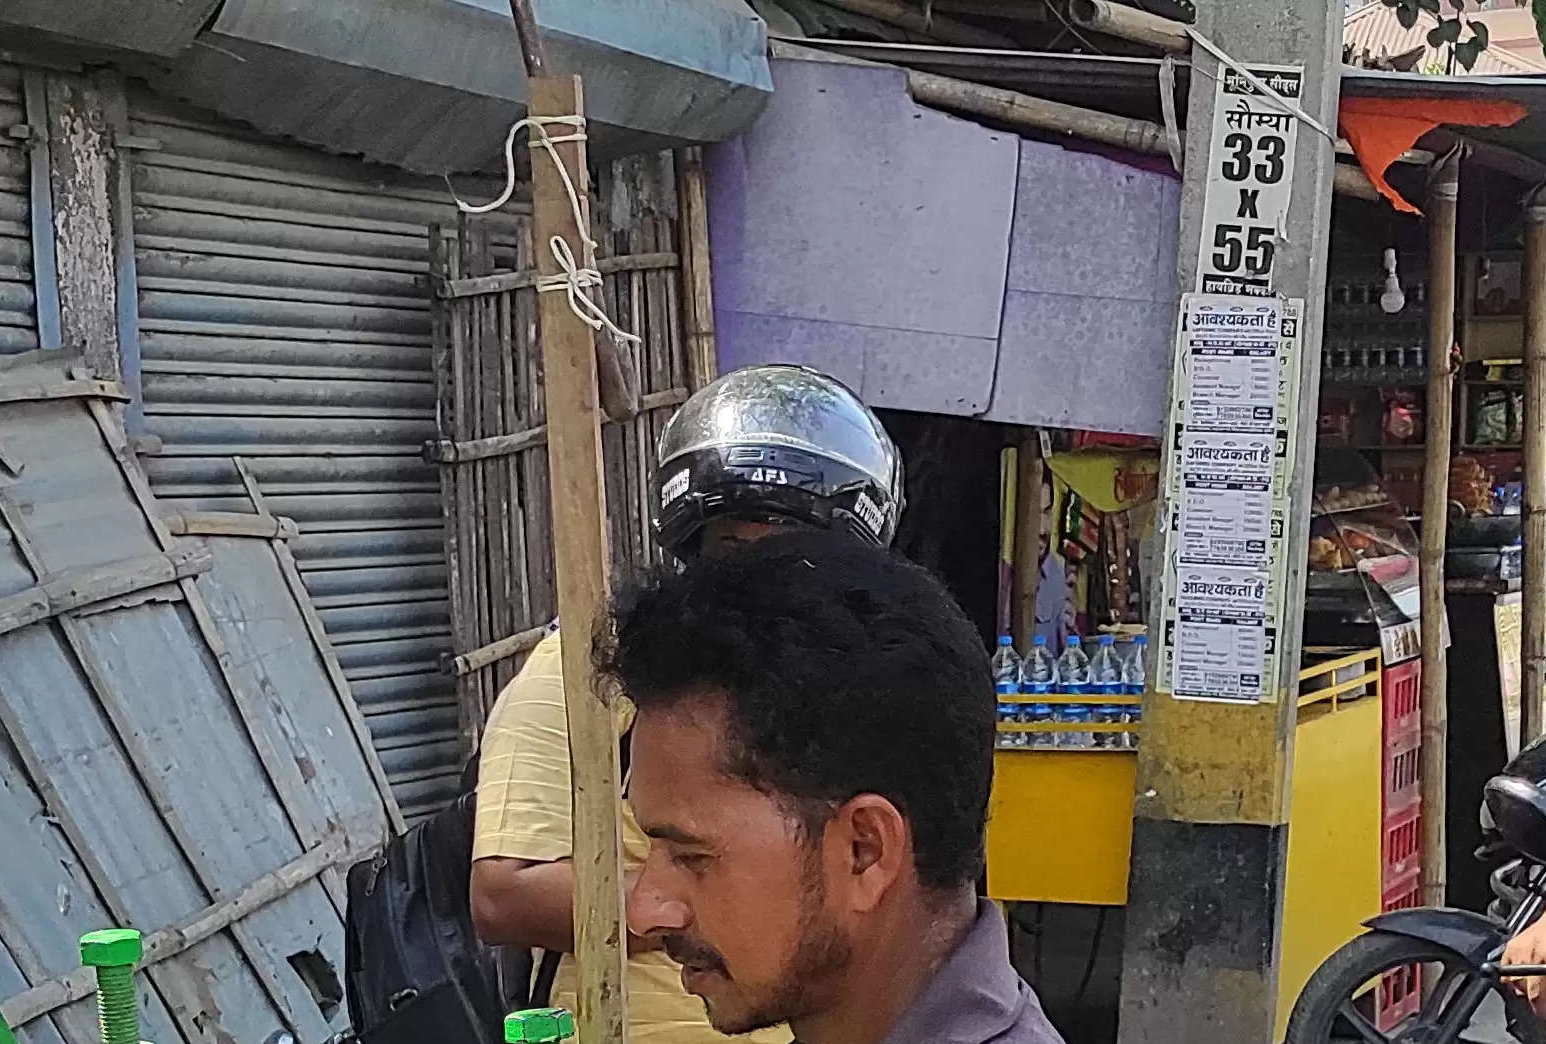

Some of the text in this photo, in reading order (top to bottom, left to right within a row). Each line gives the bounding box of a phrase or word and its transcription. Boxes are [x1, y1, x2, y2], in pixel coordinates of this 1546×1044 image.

[1225, 99, 1294, 132] सौम्या
[1222, 133, 1286, 184] 33
[1212, 224, 1276, 275] 55
[1193, 309, 1276, 328] आवश्यकता है
[1187, 445, 1271, 463] आवश्यकता है
[1181, 580, 1265, 599] आवश्यकता है
